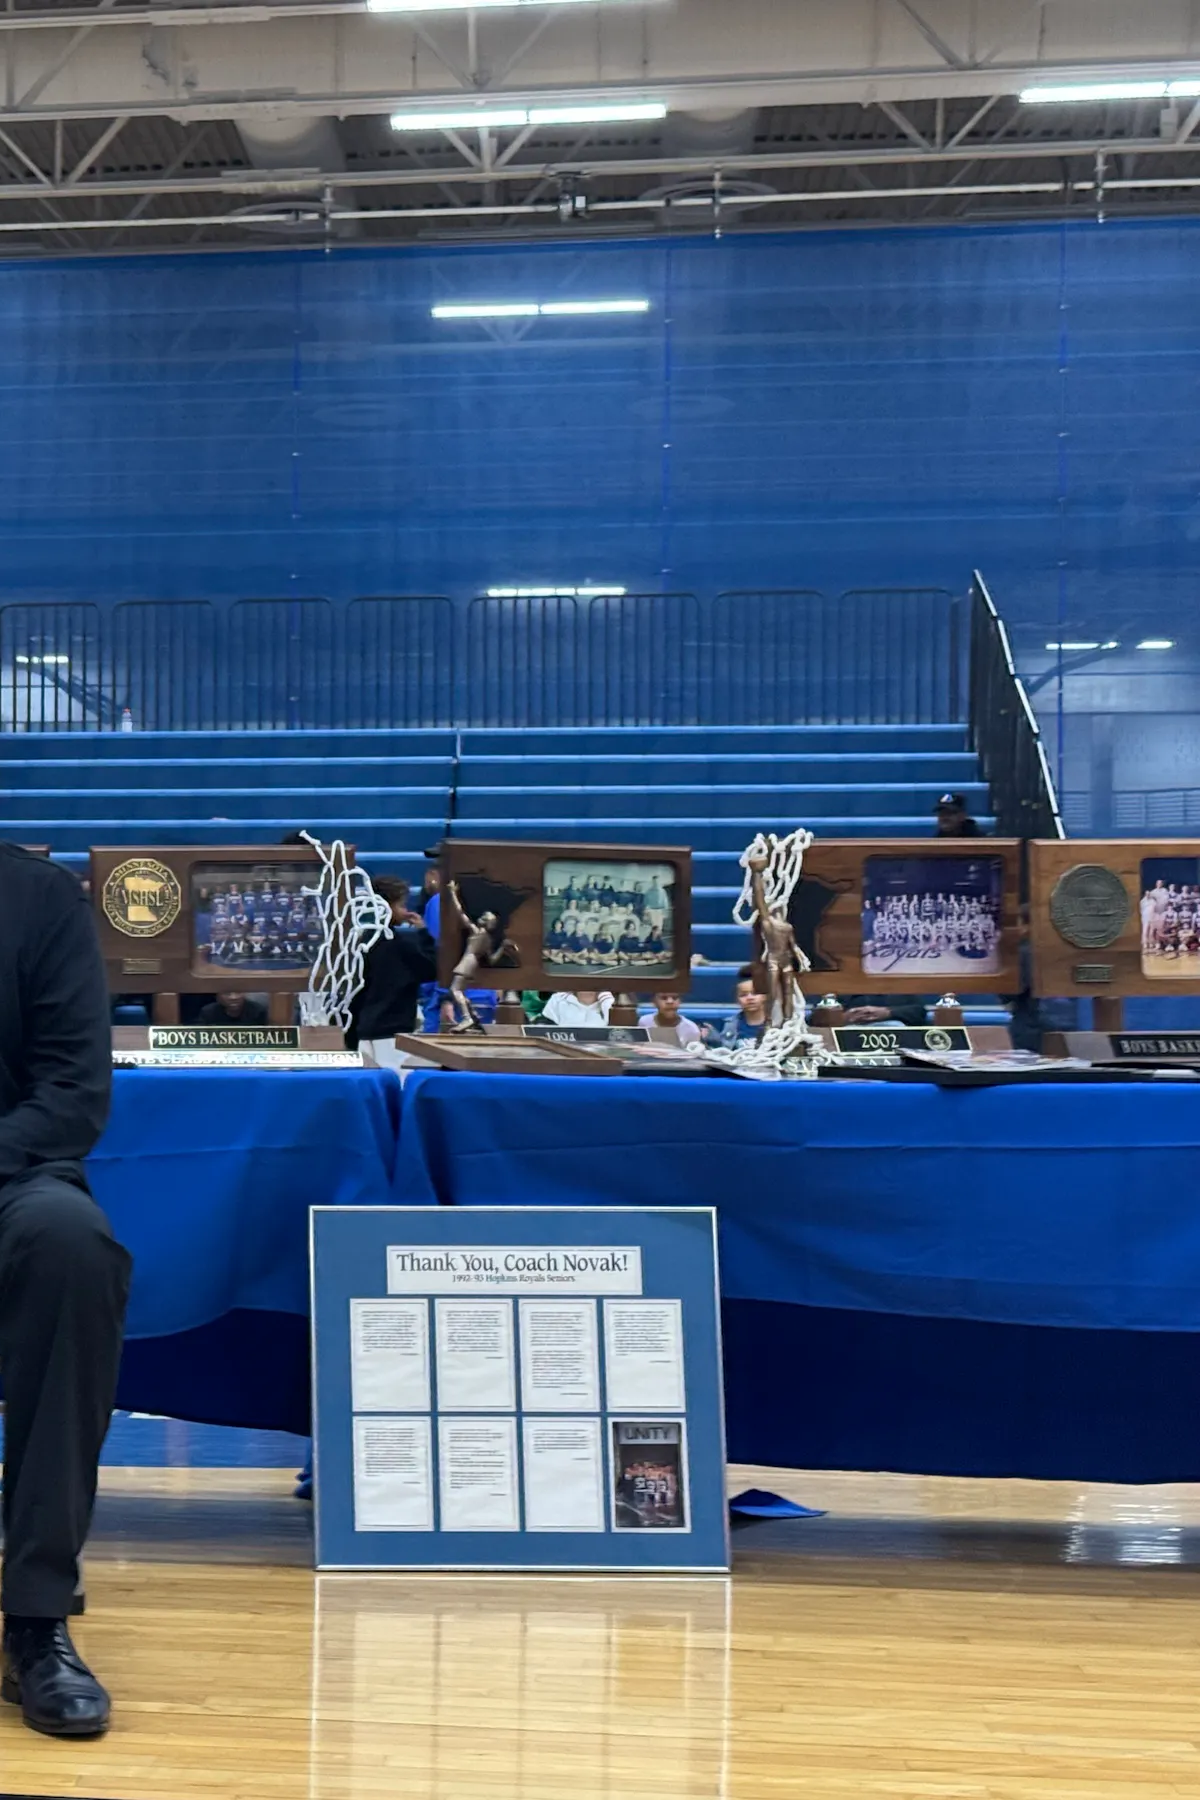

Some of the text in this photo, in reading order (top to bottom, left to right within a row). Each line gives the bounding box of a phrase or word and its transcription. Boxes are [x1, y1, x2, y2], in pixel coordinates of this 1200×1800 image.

[157, 1030, 293, 1046] BOYS BASKETBALL
[860, 1033, 900, 1049] 2002
[396, 1252, 629, 1274] Thank You, Coach Novak!
